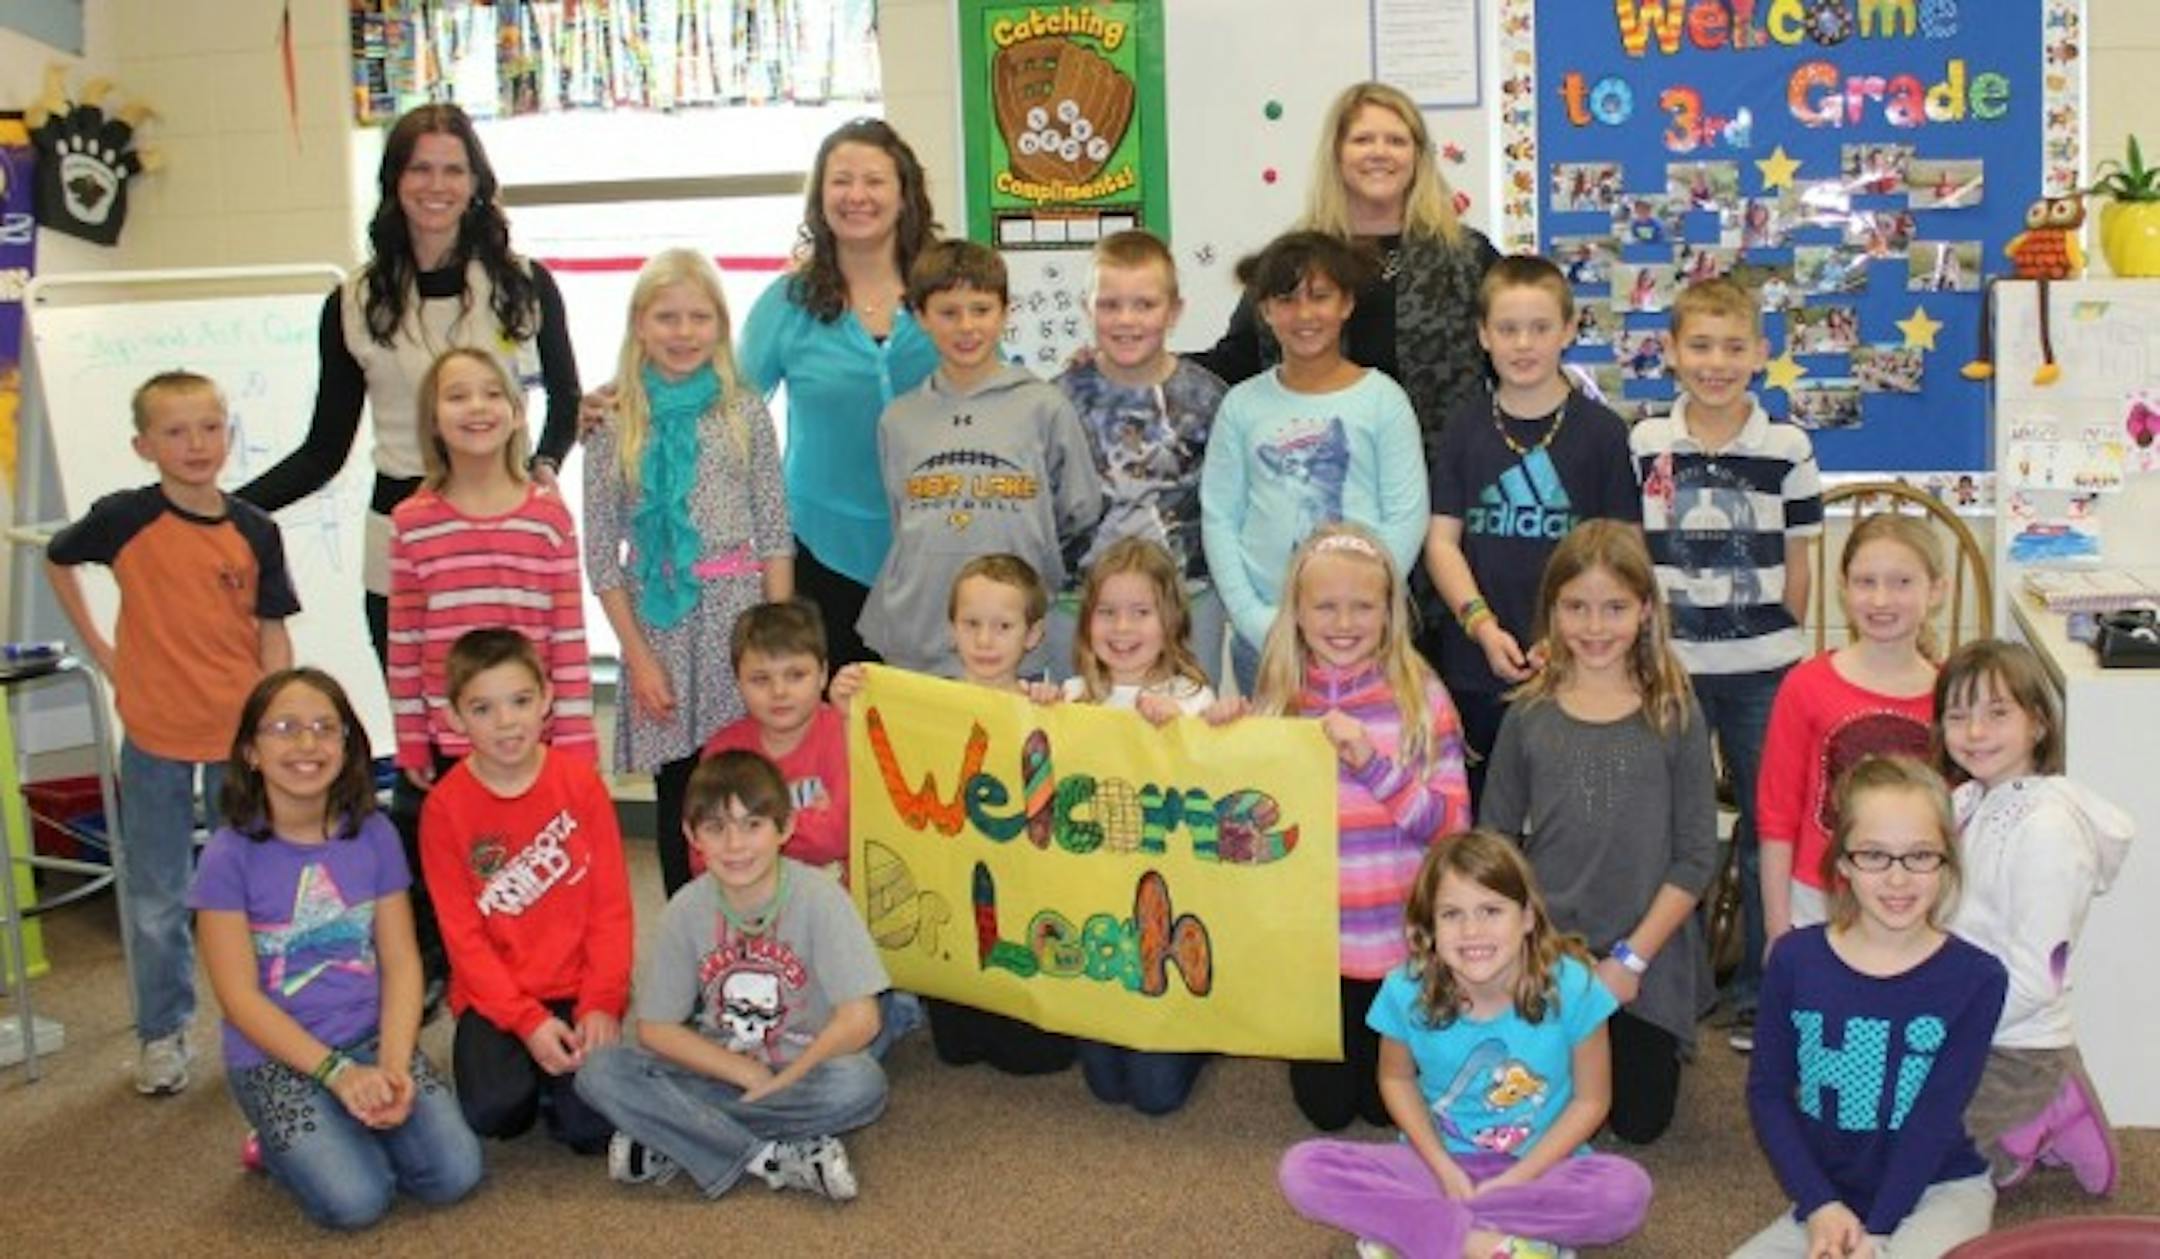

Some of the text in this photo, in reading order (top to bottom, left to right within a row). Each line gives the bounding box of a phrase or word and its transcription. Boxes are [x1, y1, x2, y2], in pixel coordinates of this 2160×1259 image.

[993, 6, 1126, 50] Catching
[1615, 0, 1958, 57] Welcome
[1559, 59, 2010, 153] to 3rd Grade
[1466, 503, 1581, 539] adida
[865, 706, 1299, 865] Welcome
[864, 840, 951, 962] Dr.
[972, 860, 1213, 998] Leah
[1790, 1009, 1947, 1130] Hi
